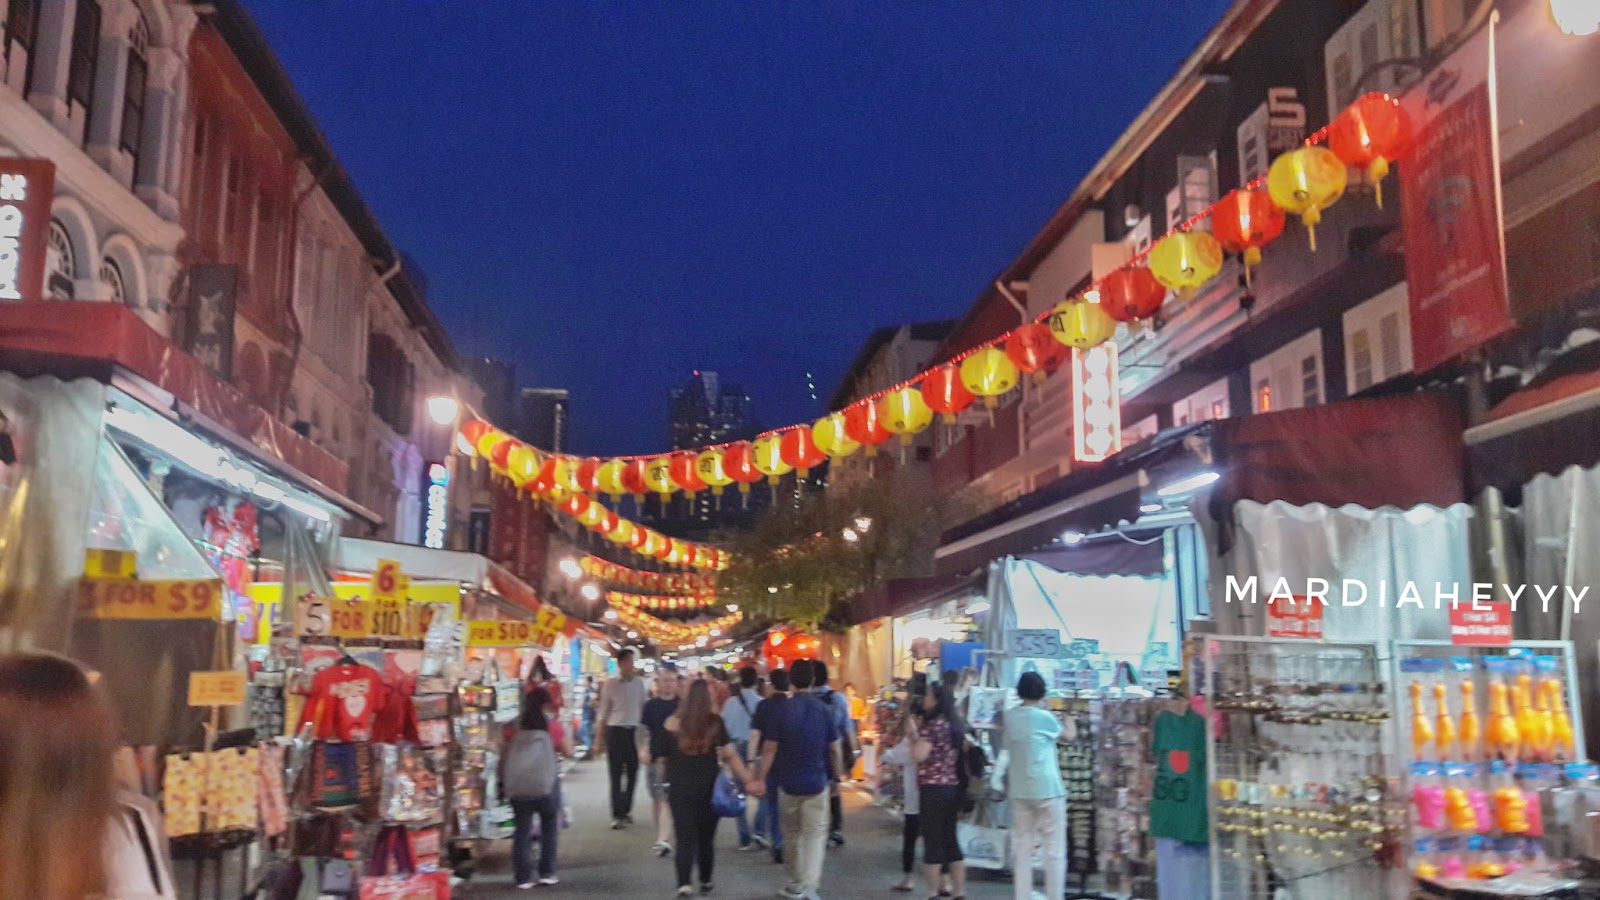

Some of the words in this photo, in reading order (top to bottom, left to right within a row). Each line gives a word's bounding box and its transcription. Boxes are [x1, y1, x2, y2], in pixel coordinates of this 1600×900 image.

[378, 563, 396, 593] 6
[104, 583, 156, 605] FOR
[331, 609, 364, 631] FOR
